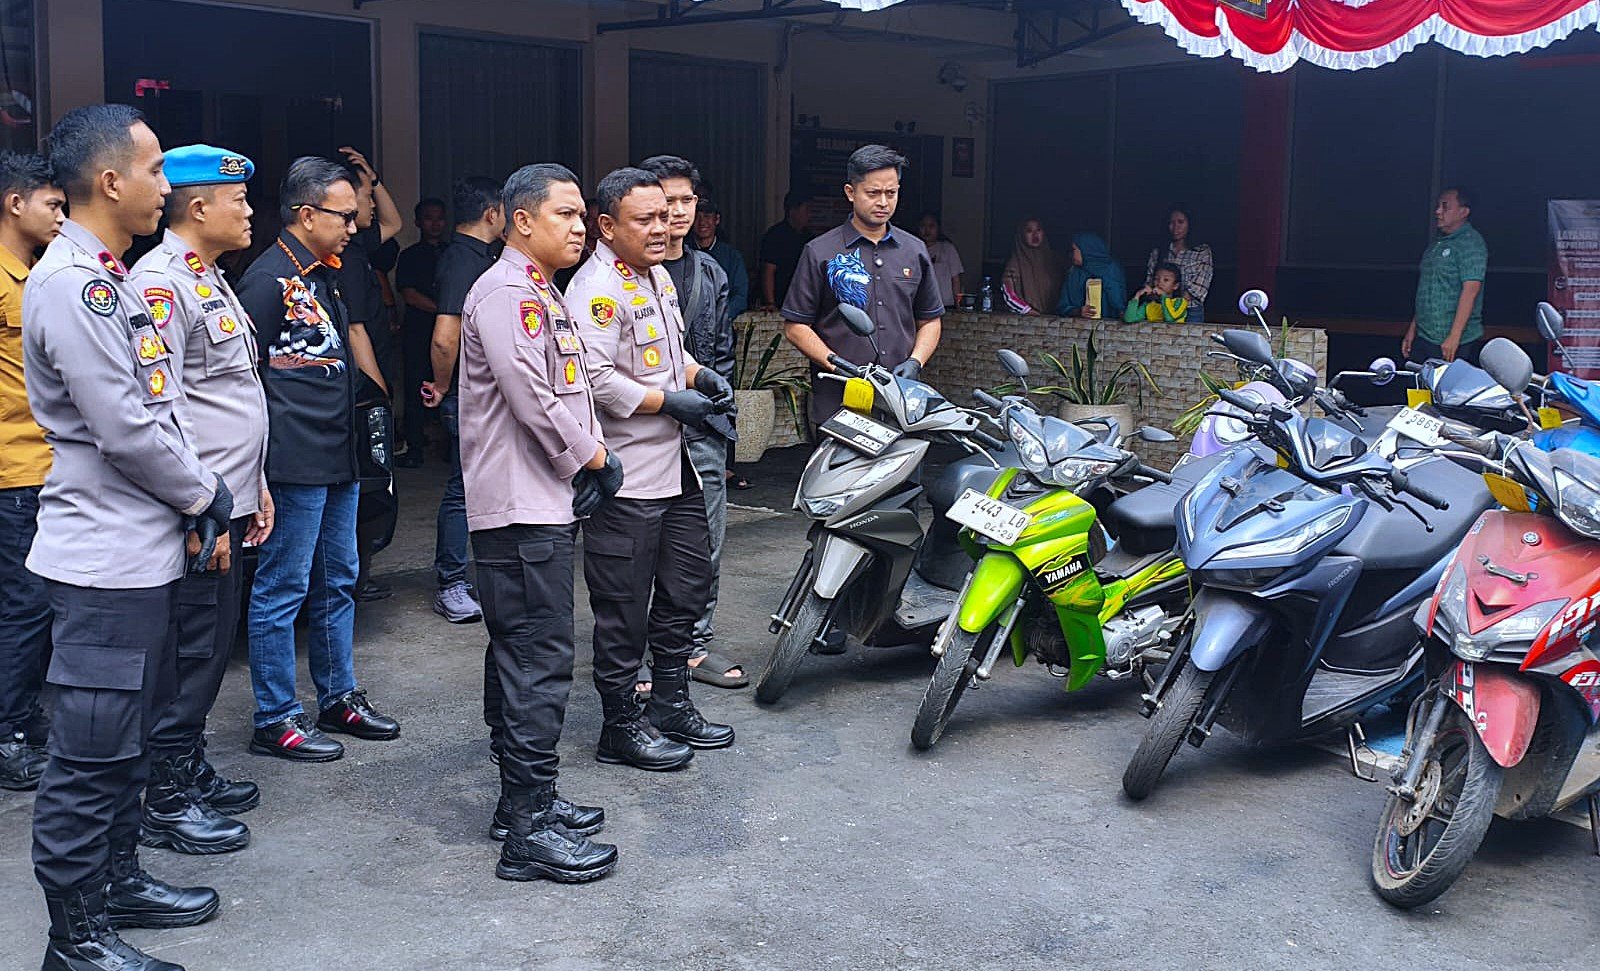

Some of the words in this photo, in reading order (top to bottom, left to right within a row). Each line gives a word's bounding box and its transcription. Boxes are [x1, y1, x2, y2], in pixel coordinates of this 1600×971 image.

[1410, 413, 1440, 432] 5865
[962, 492, 971, 500] P
[974, 498, 1003, 518] 4443
[849, 515, 880, 529] HONDA
[1044, 560, 1082, 584] YAMAHA
